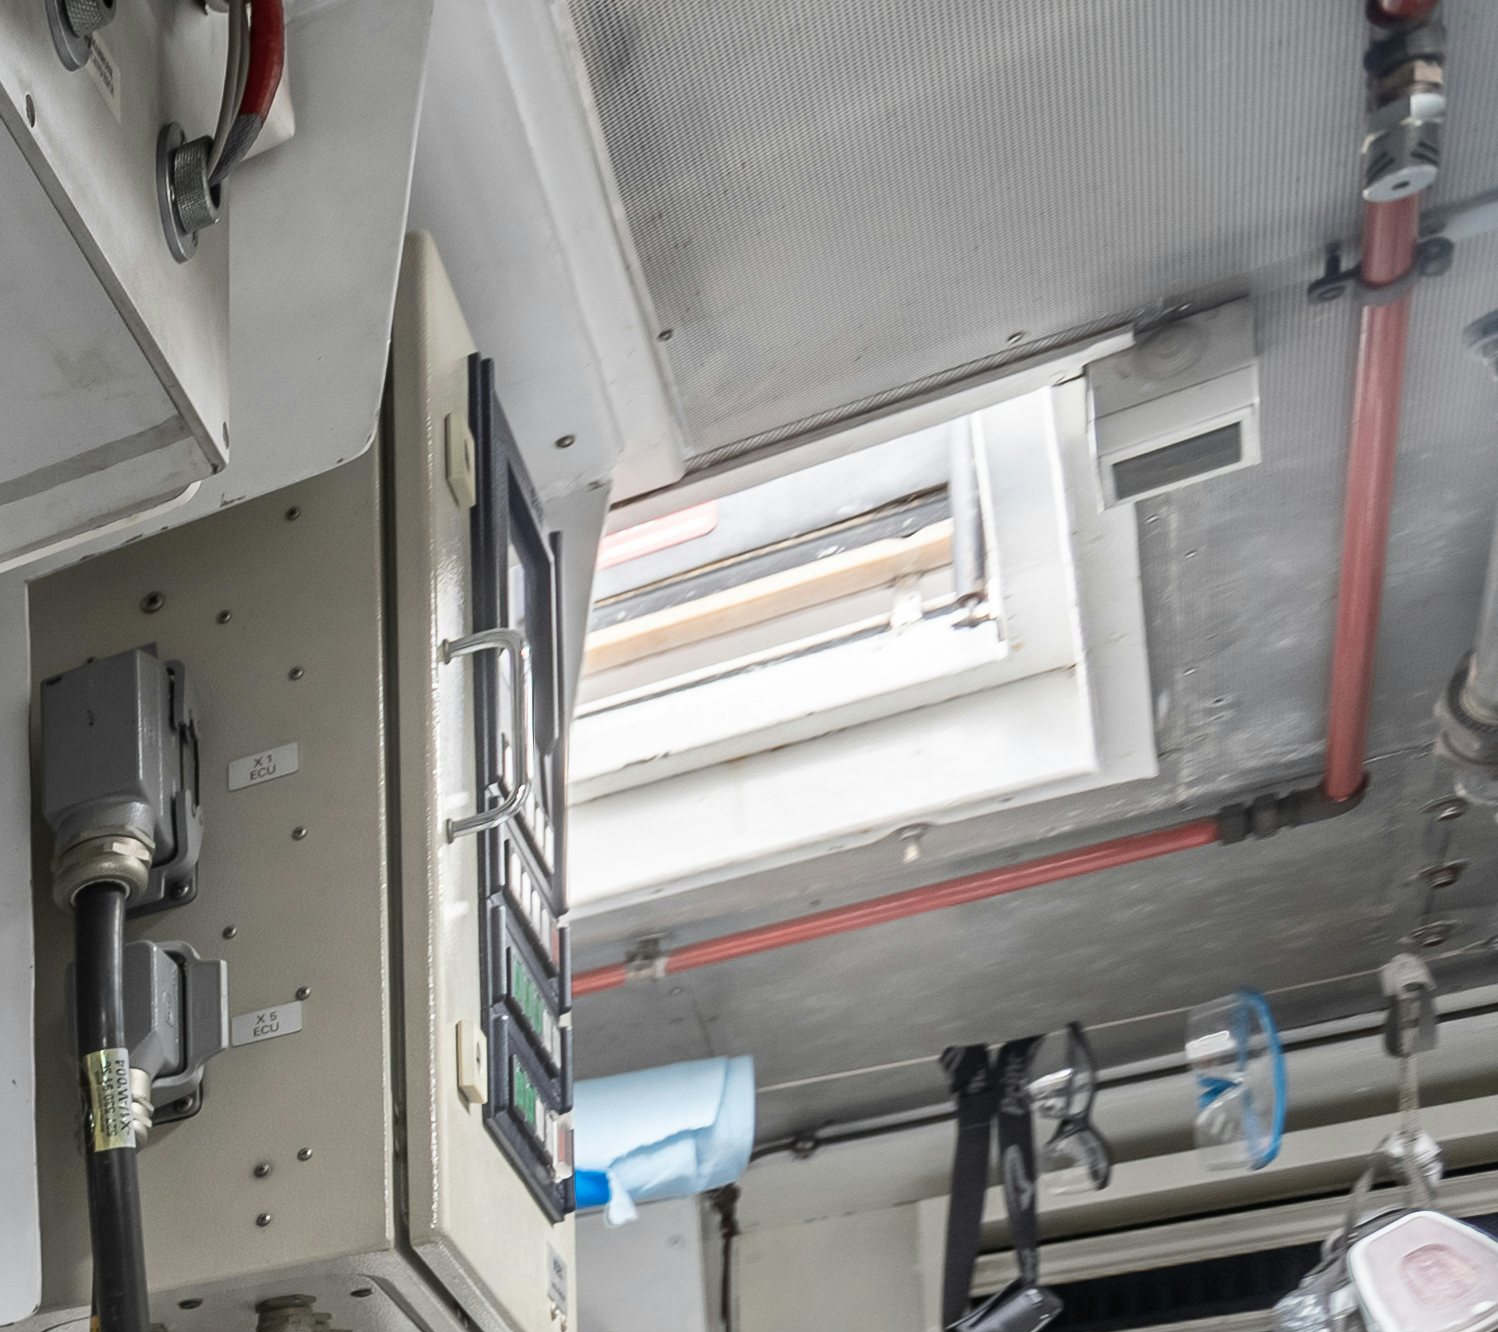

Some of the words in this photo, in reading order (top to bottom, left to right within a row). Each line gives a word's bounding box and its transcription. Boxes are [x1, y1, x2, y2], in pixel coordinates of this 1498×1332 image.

[252, 756, 264, 769] X
[249, 764, 277, 782] ECU
[255, 1013, 266, 1025] X
[269, 1011, 278, 1023] 5
[252, 1021, 280, 1038] ECU
